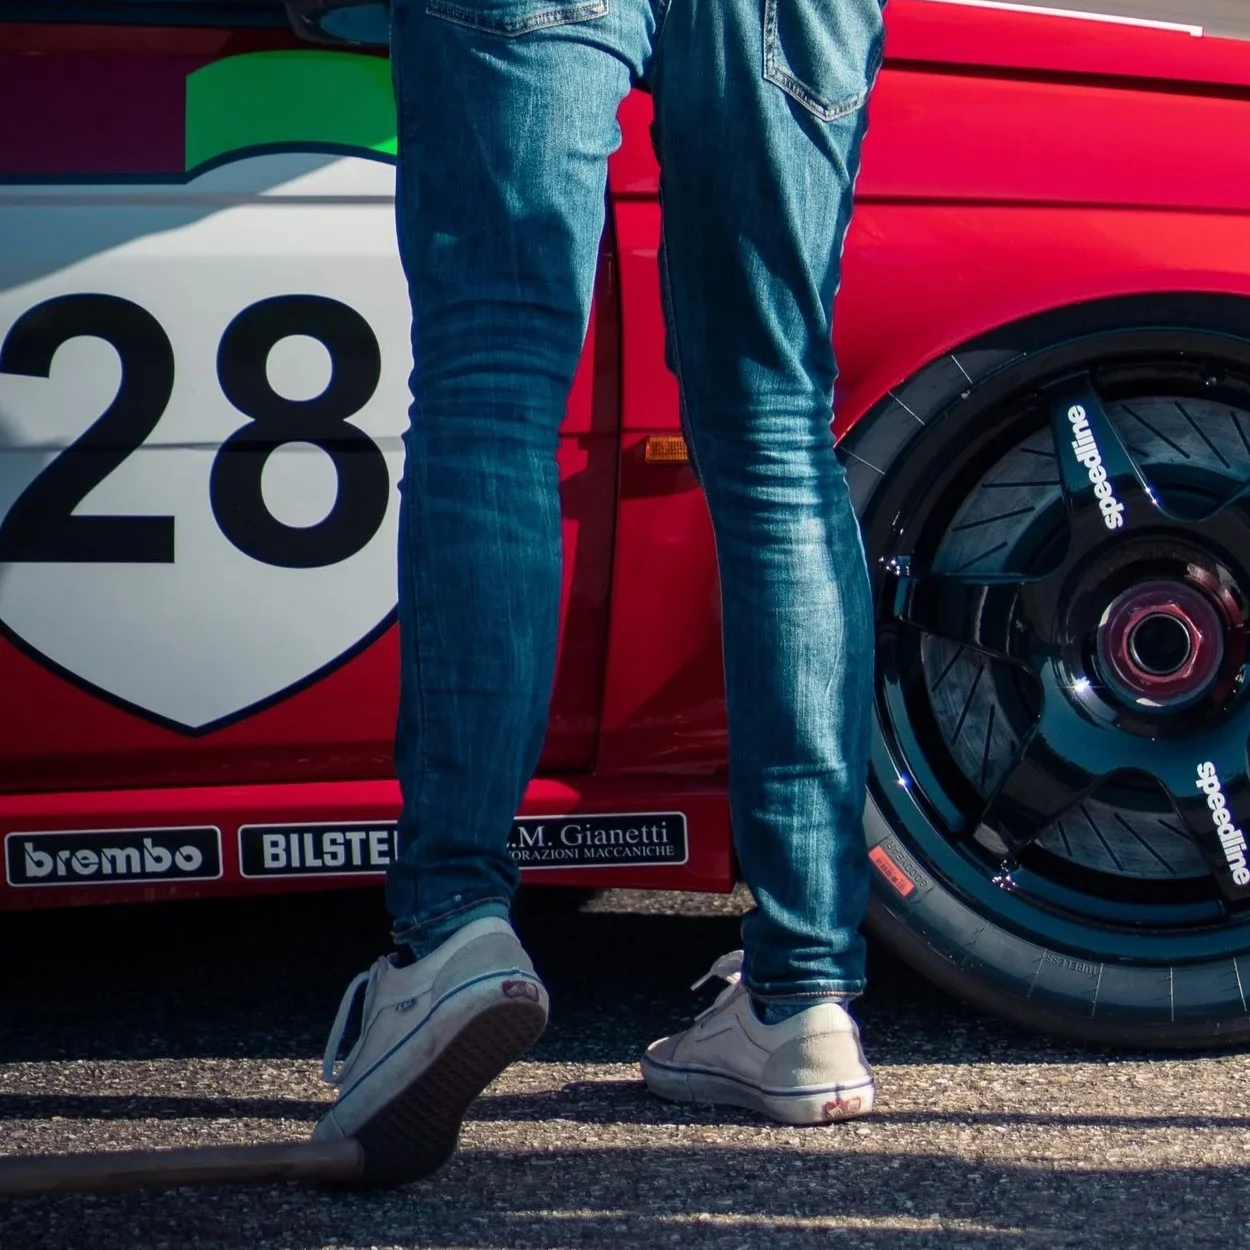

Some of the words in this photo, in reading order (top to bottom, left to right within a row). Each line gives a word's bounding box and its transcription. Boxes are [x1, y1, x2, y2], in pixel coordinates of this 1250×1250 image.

[0, 293, 390, 568] 28
[1067, 405, 1125, 530] speedline
[560, 821, 669, 847] Gianetti
[1196, 761, 1250, 886] speedline
[24, 838, 202, 880] brembo
[262, 830, 398, 869] BILSTE
[508, 848, 580, 861] ORAZIONI
